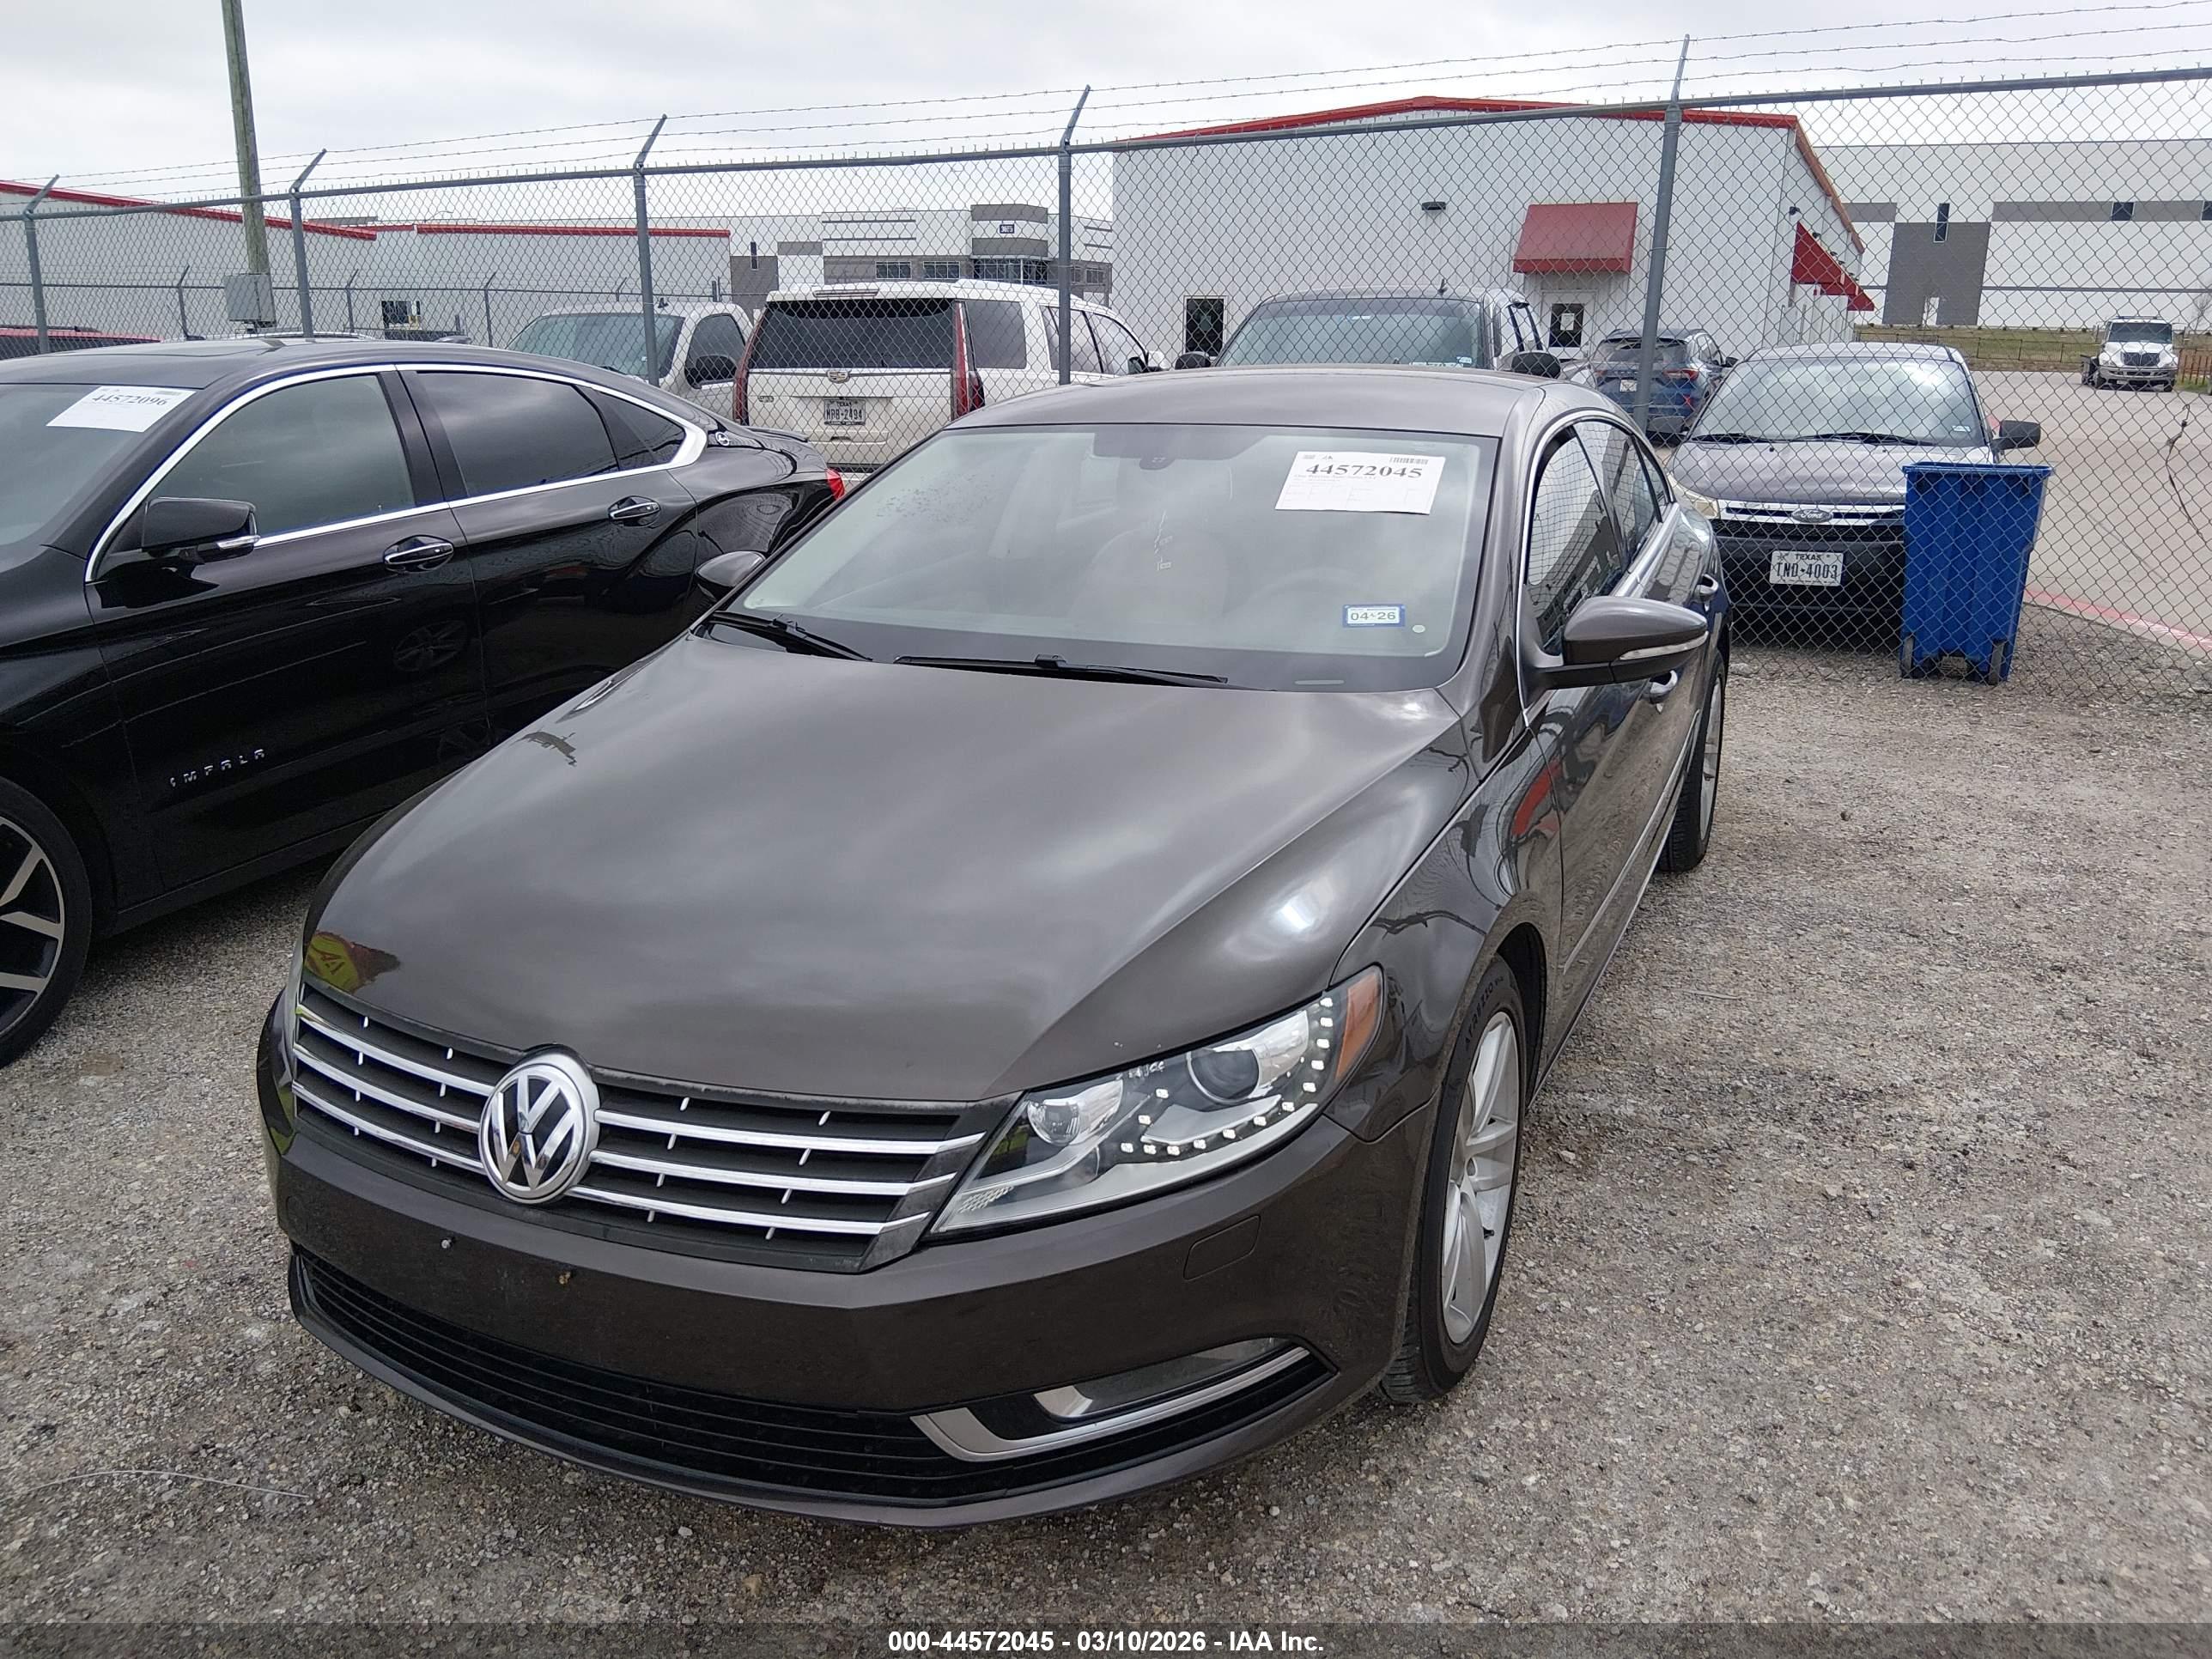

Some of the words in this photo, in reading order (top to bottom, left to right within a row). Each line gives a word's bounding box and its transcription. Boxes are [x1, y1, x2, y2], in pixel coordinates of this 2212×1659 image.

[92, 394, 168, 406] 44572096
[1305, 464, 1424, 479] 44572045
[170, 749, 265, 787] IMPALA
